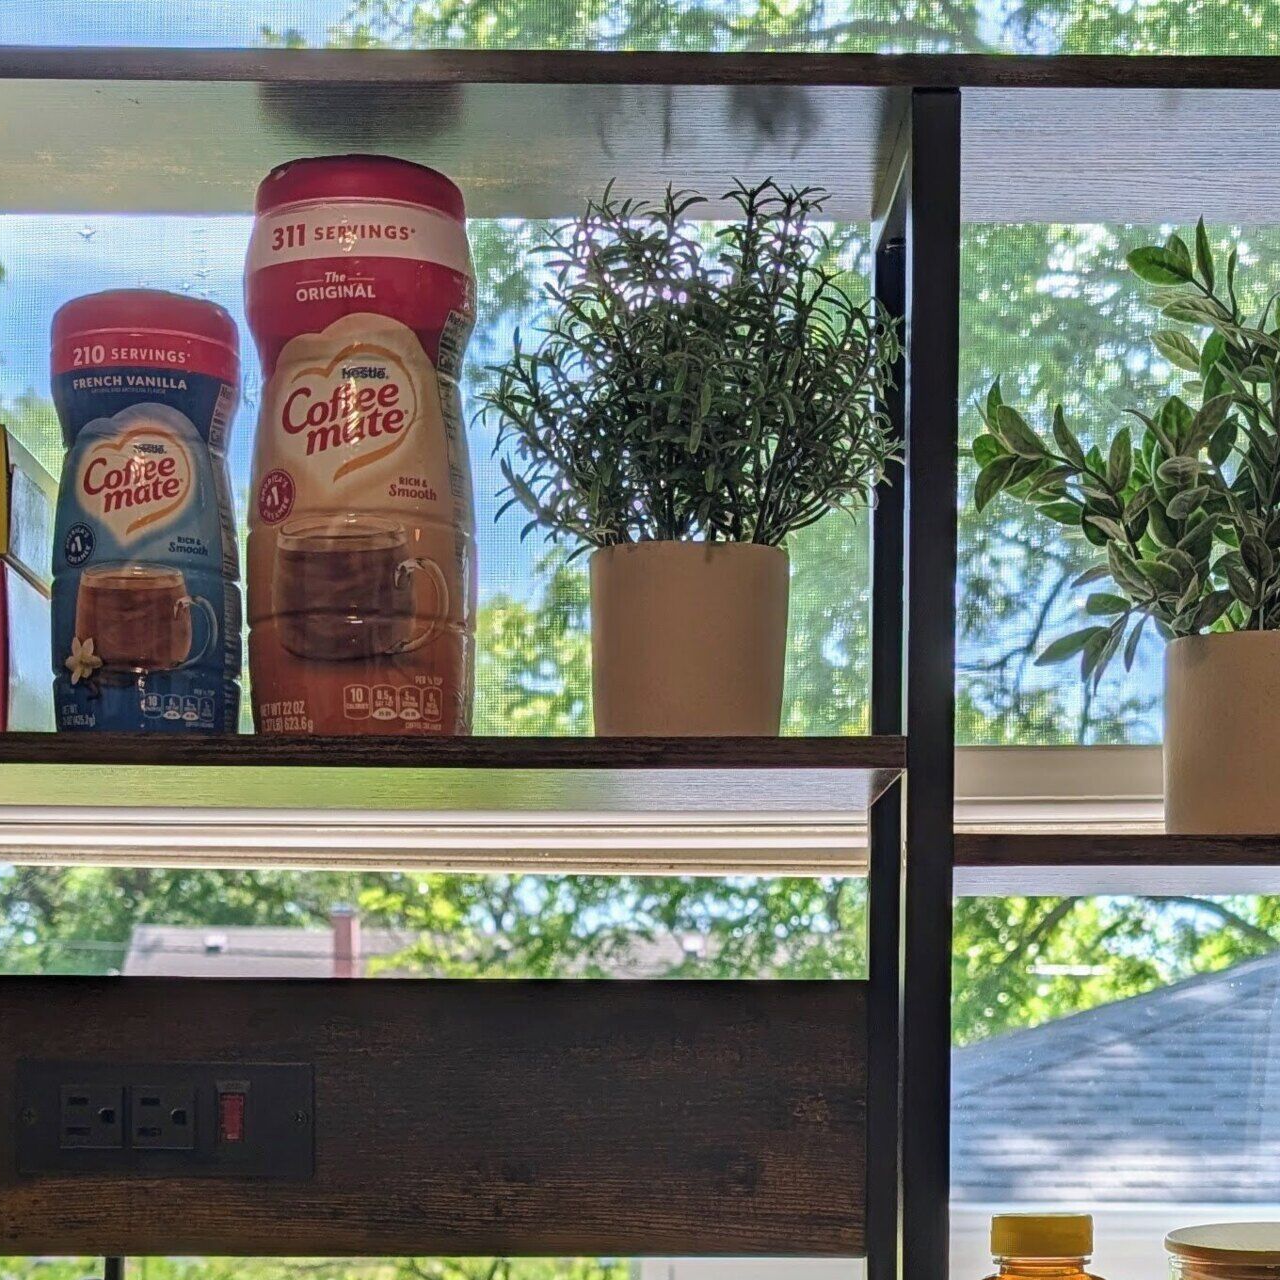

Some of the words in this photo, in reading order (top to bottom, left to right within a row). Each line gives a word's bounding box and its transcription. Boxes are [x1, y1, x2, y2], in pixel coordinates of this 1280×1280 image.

[271, 223, 306, 251] 311
[324, 271, 346, 283] The
[296, 283, 376, 302] ORIGINAL
[73, 344, 105, 367] 210
[73, 376, 122, 390] FRENCH
[127, 376, 187, 390] VANILLA
[282, 383, 400, 435] Coffee
[306, 408, 405, 456] mate
[83, 457, 176, 495] Coffee
[399, 476, 420, 487] RICH
[421, 478, 428, 488] &
[104, 476, 180, 513] mate
[388, 484, 437, 501] Smooth
[169, 542, 208, 556] Smooth
[177, 536, 195, 545] RICH
[350, 688, 363, 703] 10
[271, 702, 281, 716] WT
[282, 701, 292, 715] 22
[293, 700, 306, 715] OZ
